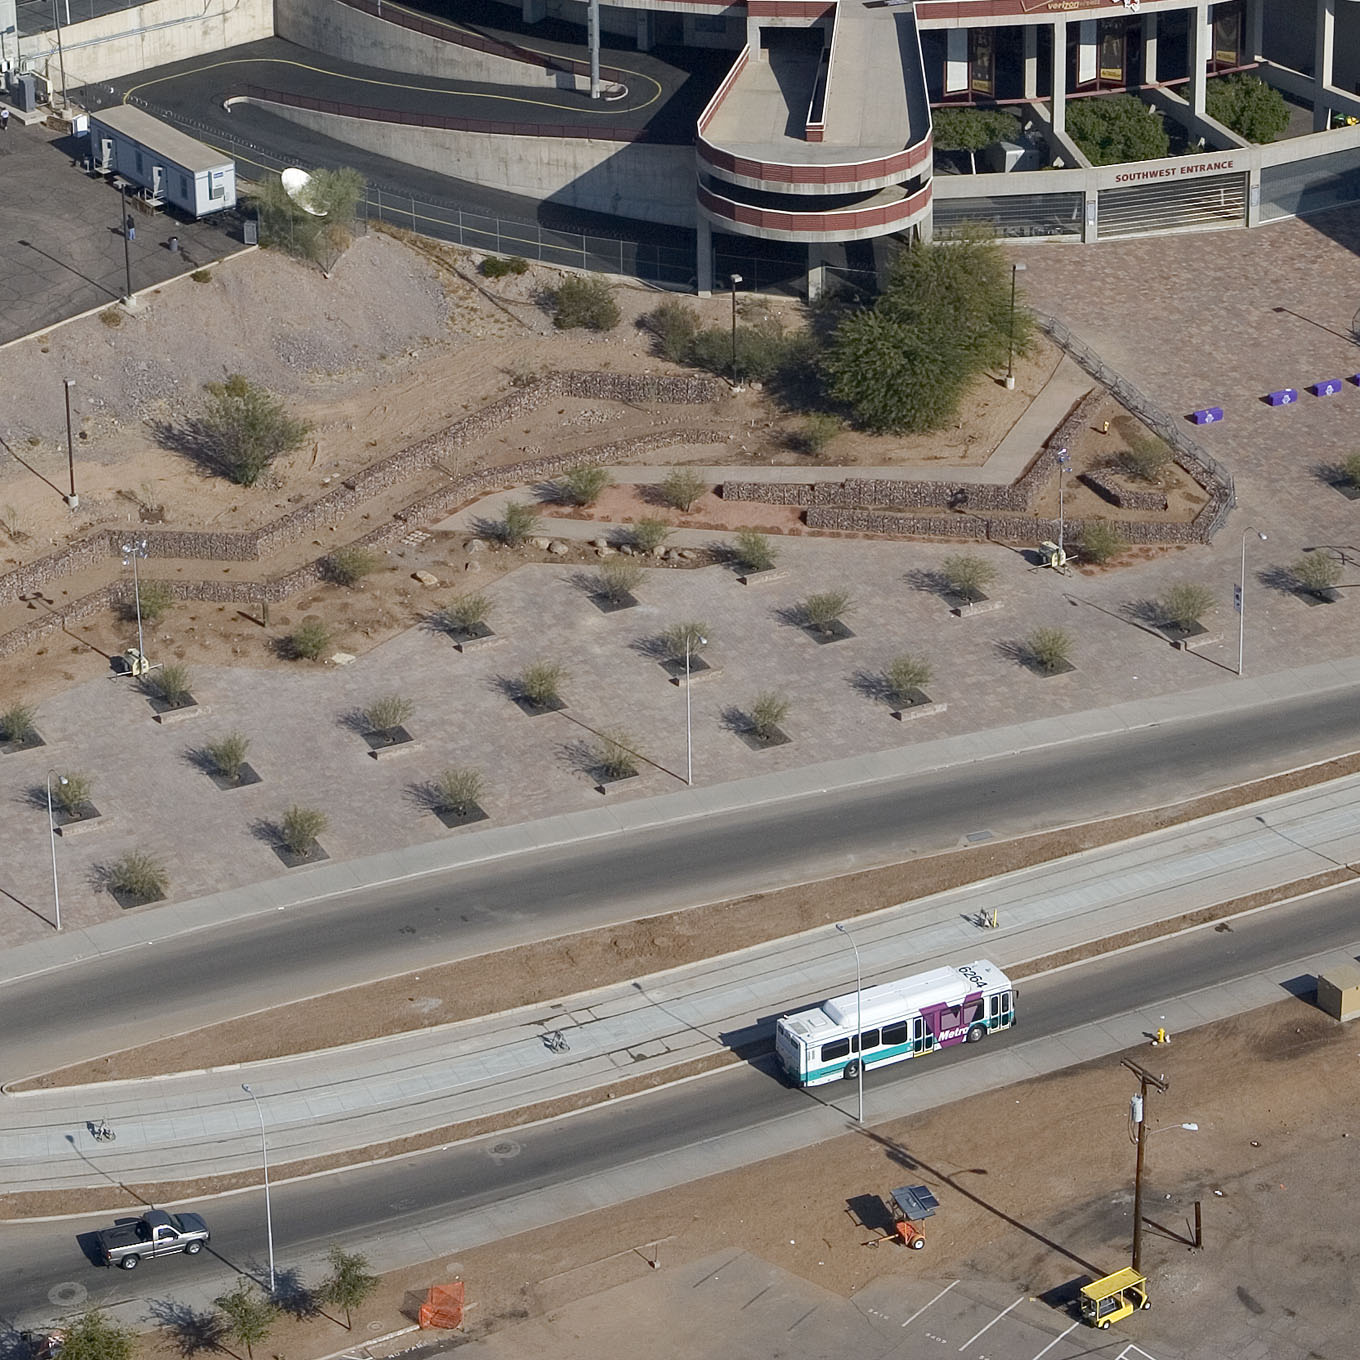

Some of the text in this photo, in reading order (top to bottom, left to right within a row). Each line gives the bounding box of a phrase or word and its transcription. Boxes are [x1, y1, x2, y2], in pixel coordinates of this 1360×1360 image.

[1047, 0, 1080, 11] verizon
[1115, 160, 1234, 183] SOUTHWEST ENTRANCE
[958, 966, 988, 989] 6264
[938, 1026, 969, 1042] Metro
